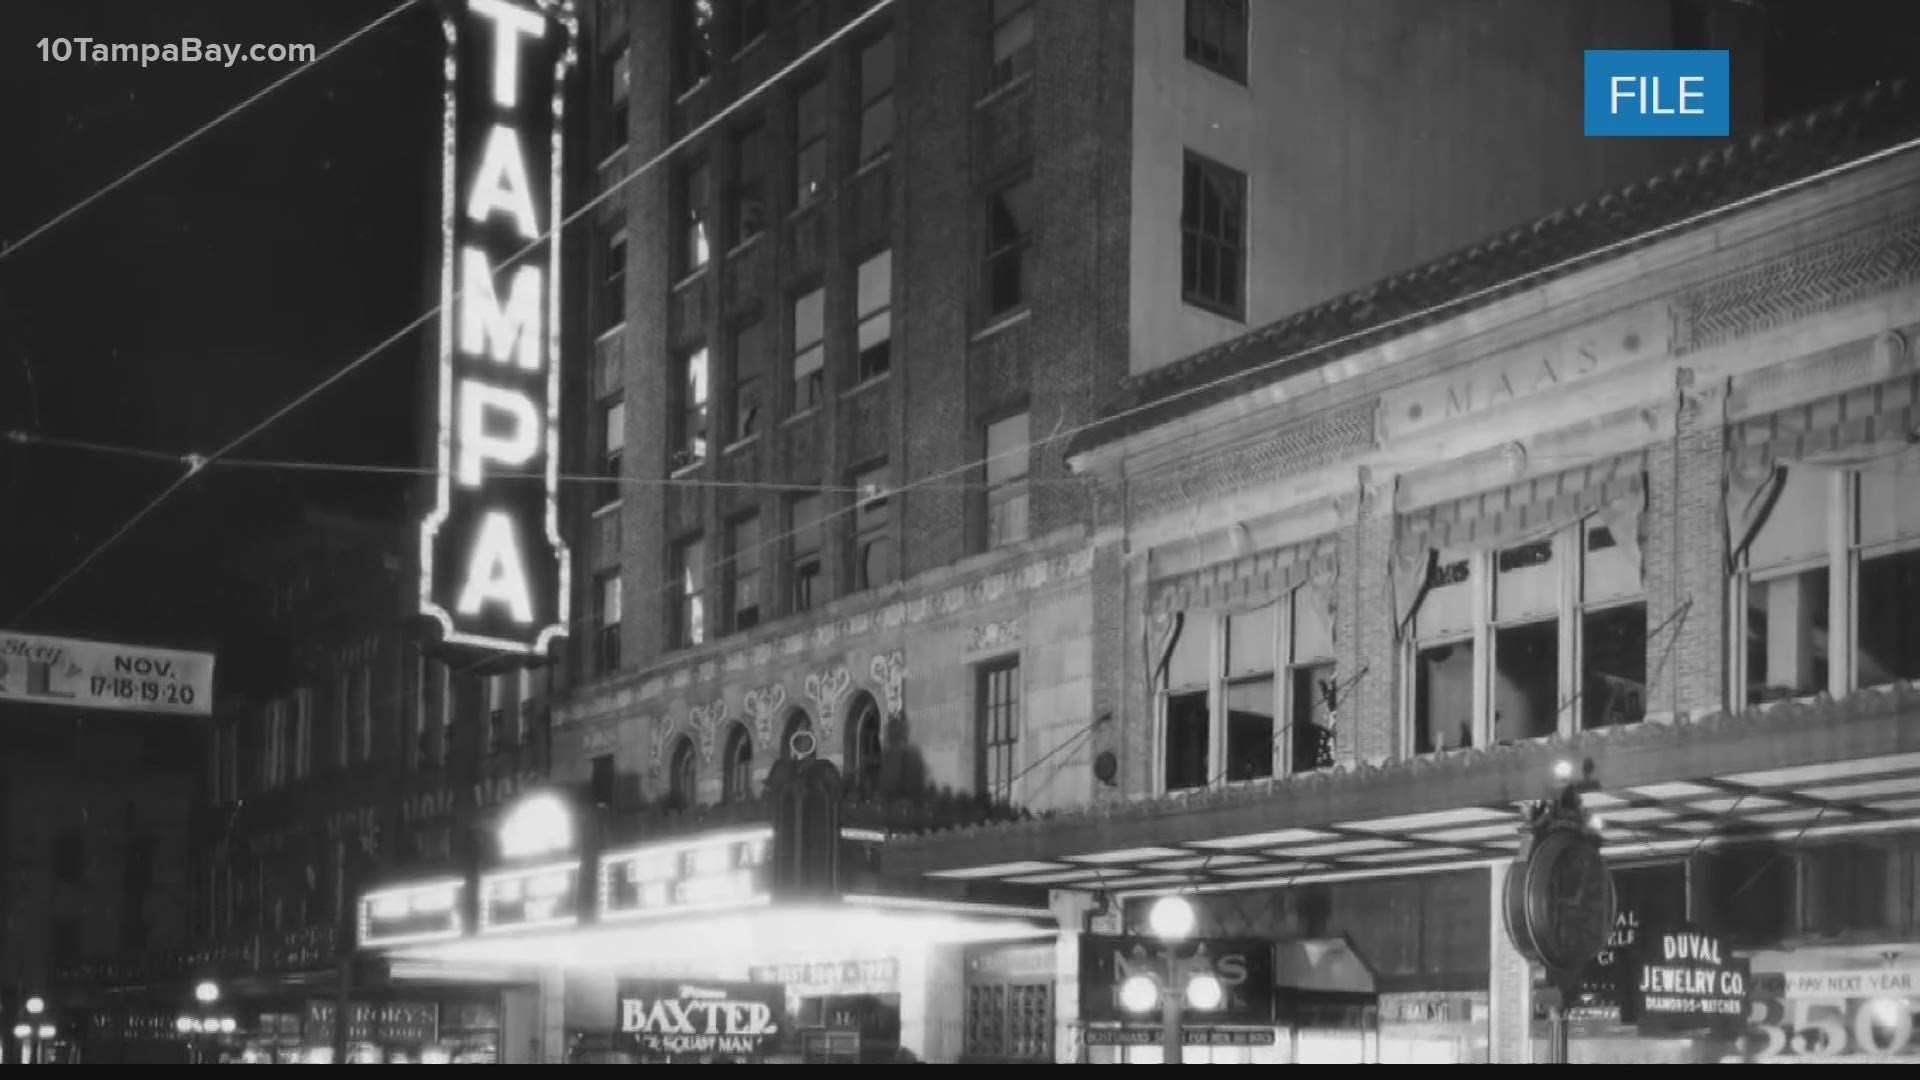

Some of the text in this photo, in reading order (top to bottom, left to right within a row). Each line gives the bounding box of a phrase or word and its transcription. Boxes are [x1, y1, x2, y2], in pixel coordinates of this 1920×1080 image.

[456, 0, 546, 624] TAMPA
[1444, 345, 1599, 416] MAAS
[114, 655, 176, 678] NOV.
[1663, 933, 1722, 965] DUVAL
[1639, 965, 1746, 996] JEWELRY CO.
[1869, 973, 1912, 989] YEAR
[621, 998, 778, 1035] BAXTER
